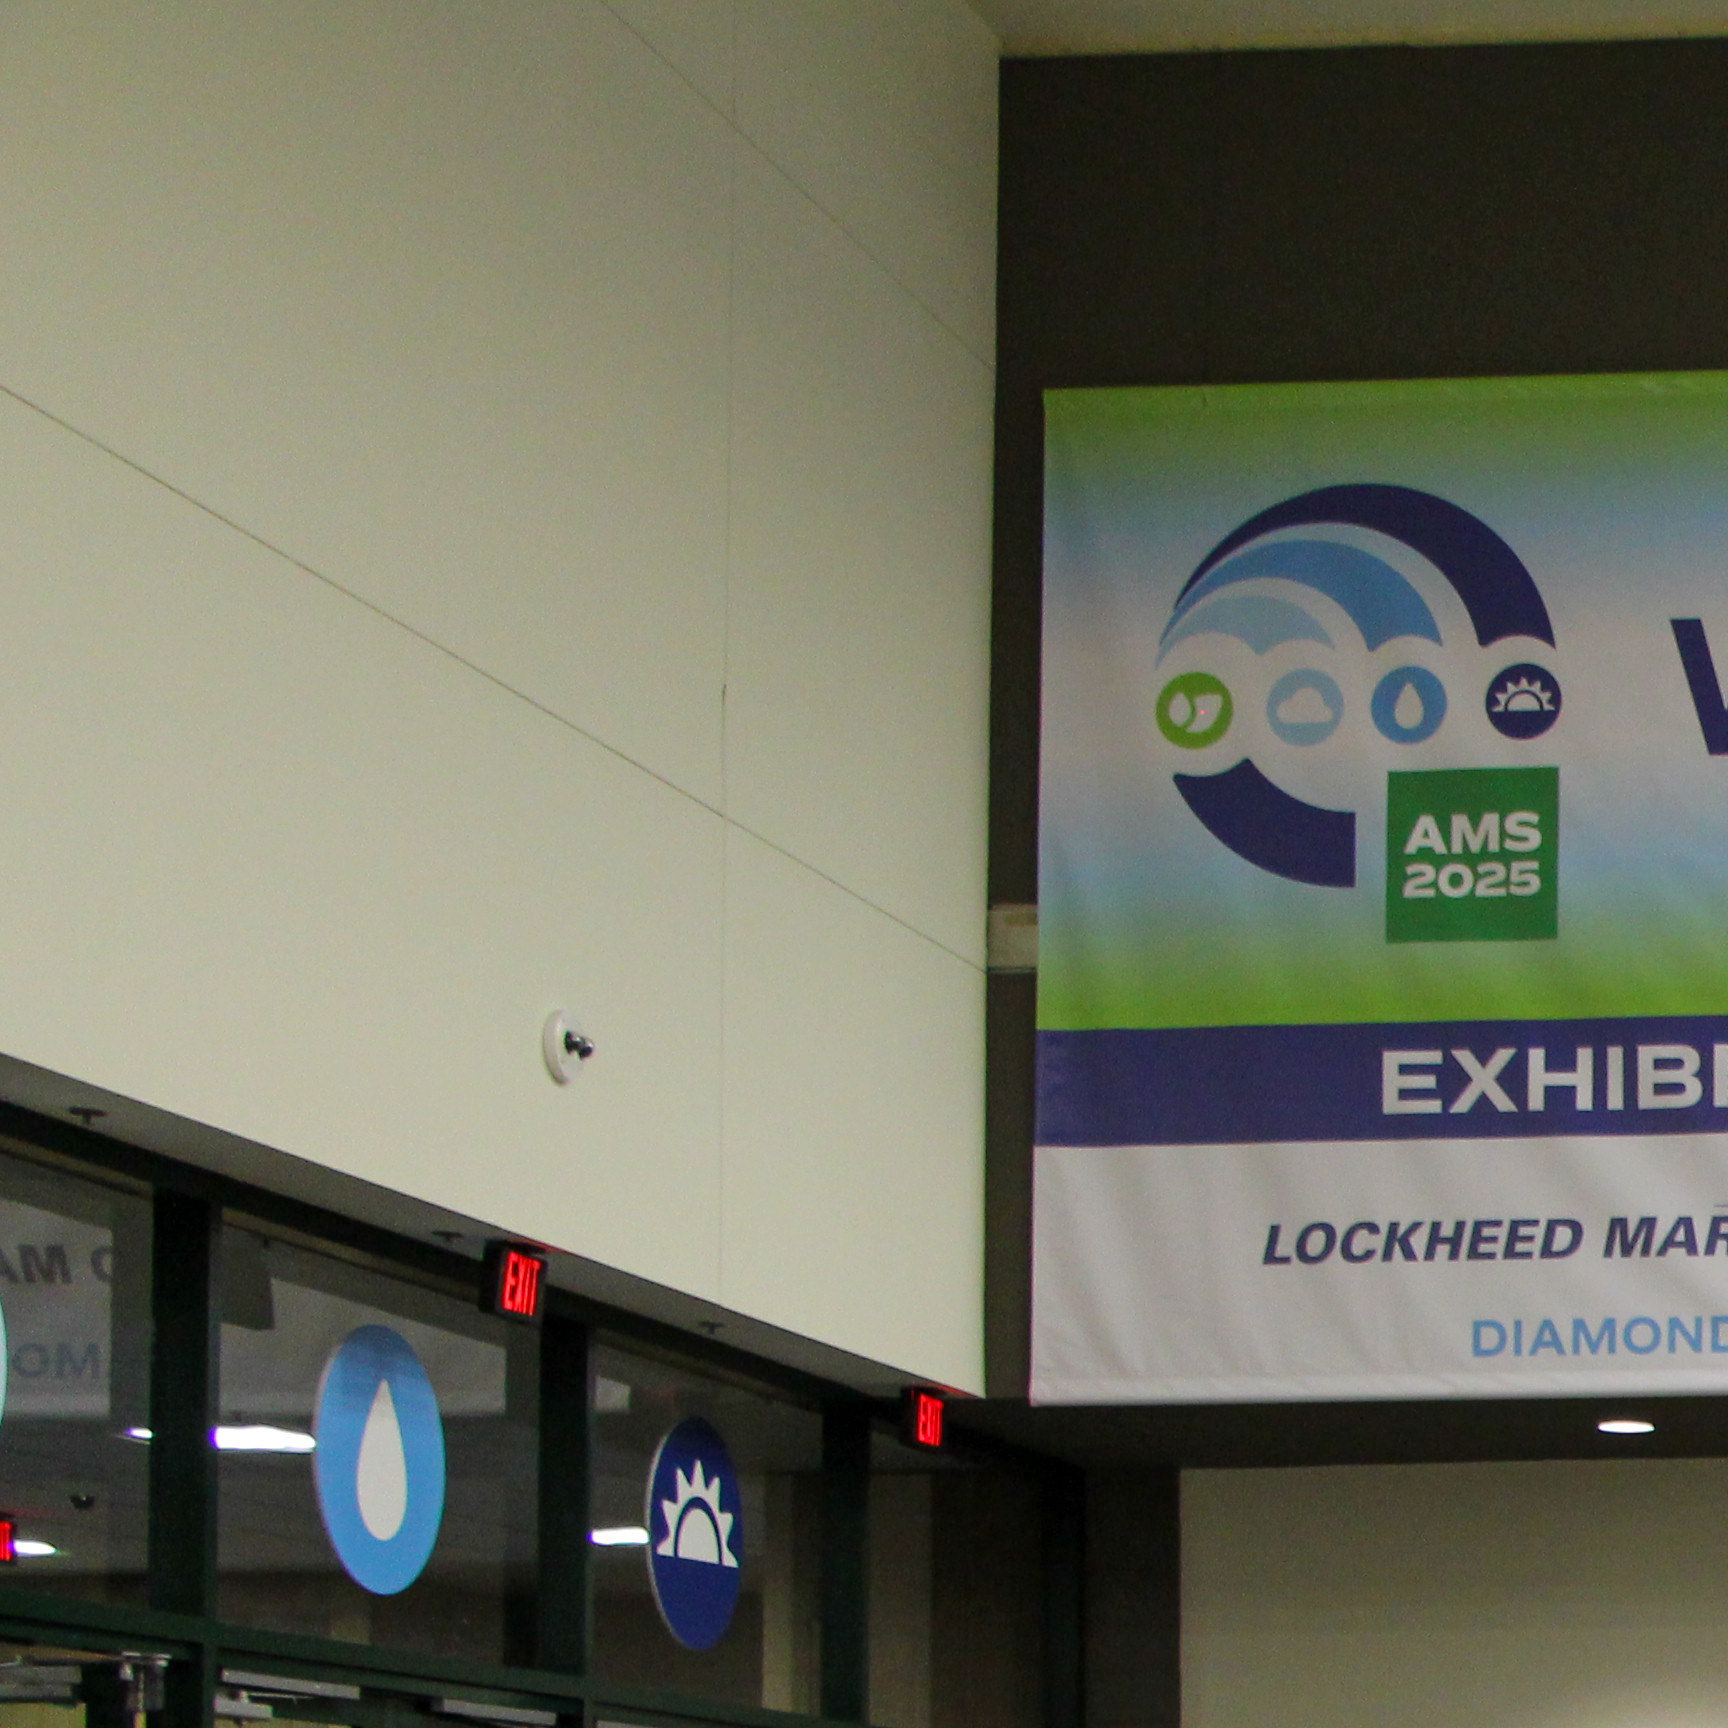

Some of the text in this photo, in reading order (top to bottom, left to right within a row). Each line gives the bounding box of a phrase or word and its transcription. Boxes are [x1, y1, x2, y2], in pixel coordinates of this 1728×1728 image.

[1404, 811, 1541, 853] AMS
[1403, 860, 1540, 897] 2025
[1263, 1219, 1583, 1264] LOCKHEED
[502, 1252, 542, 1315] EXIT
